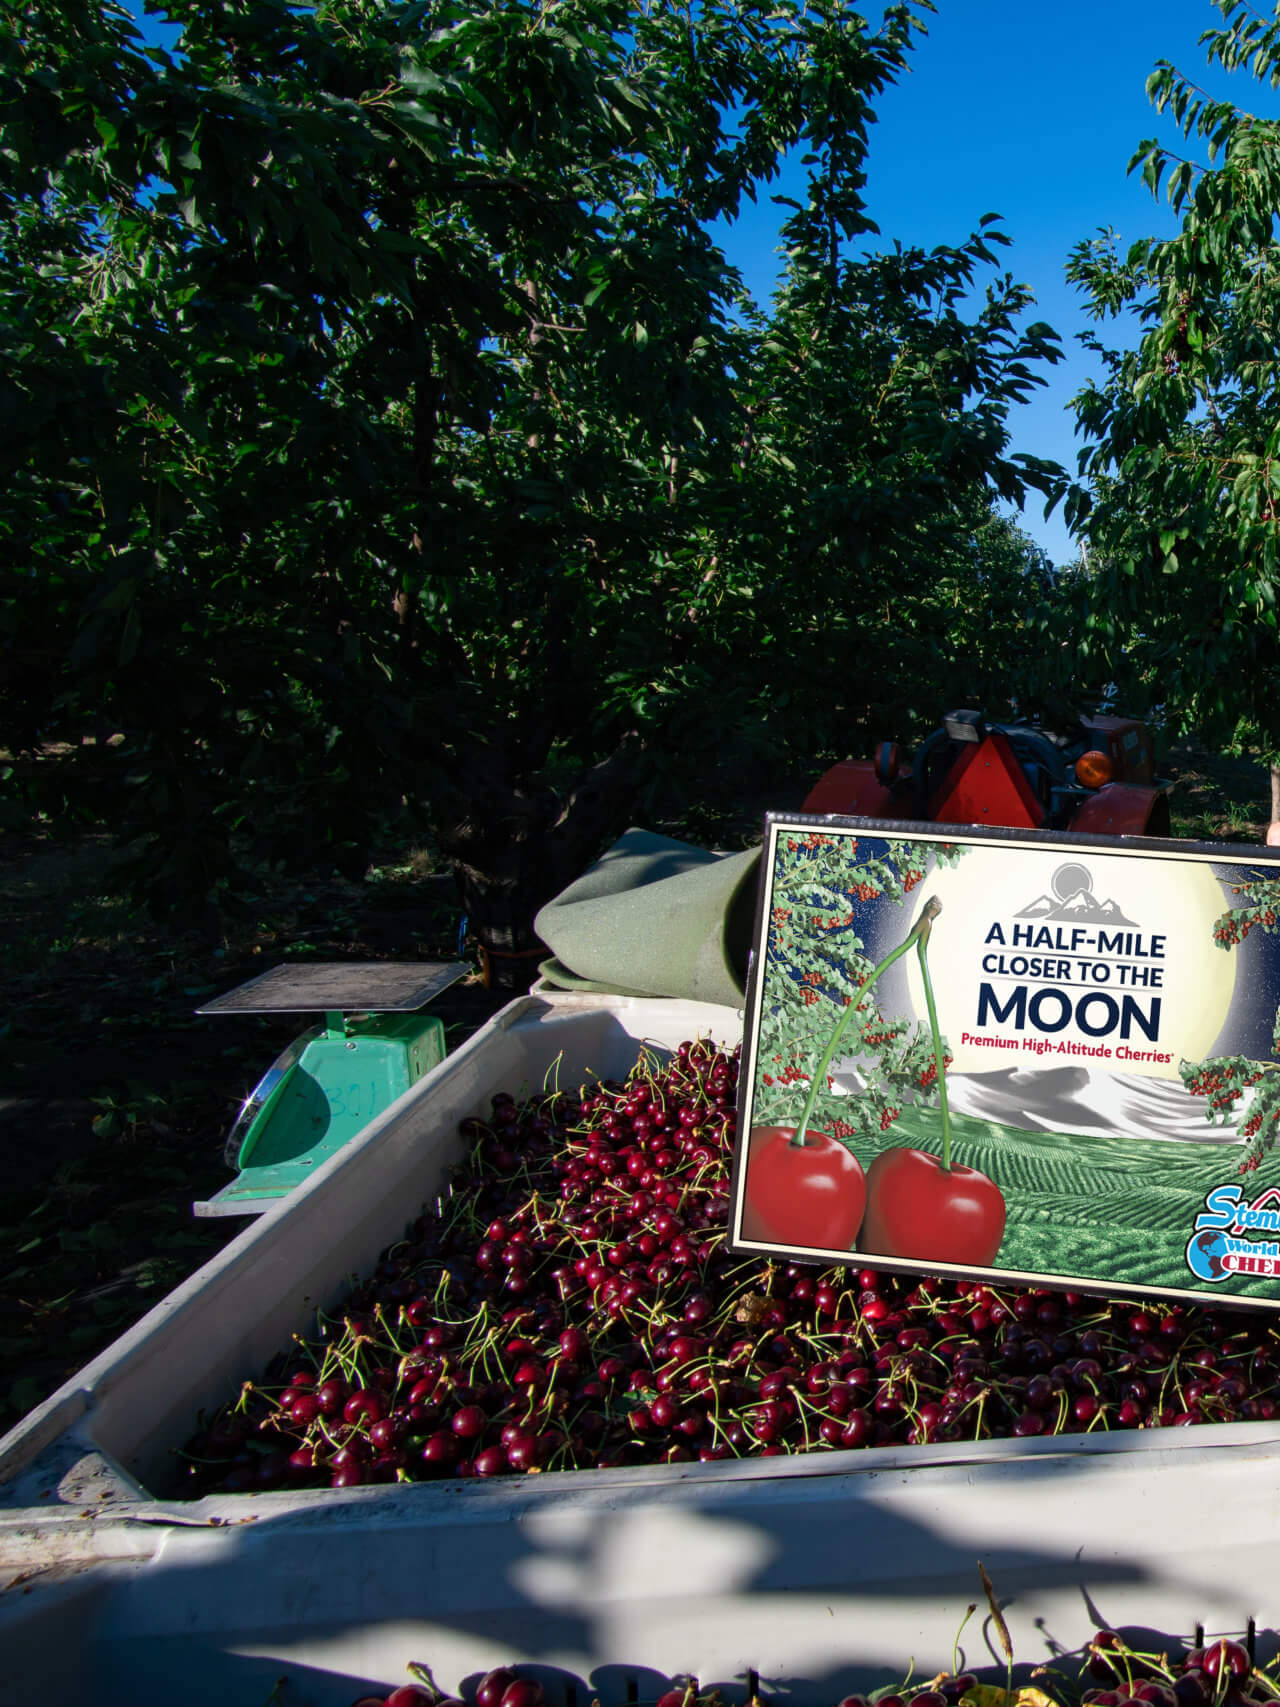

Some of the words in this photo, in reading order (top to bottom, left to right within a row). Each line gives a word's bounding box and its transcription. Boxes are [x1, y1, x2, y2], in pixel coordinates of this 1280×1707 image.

[984, 922, 1006, 946] A
[1012, 924, 1167, 958] HALF-MILE
[982, 953, 1071, 981] CLOSER
[1077, 961, 1111, 983] TO
[1116, 964, 1164, 988] THE
[976, 982, 1162, 1042] MOON
[961, 1032, 1020, 1051] Premium
[1022, 1037, 1112, 1058] High-Altitude
[1115, 1046, 1174, 1063] Cherries
[1227, 1238, 1280, 1257] World
